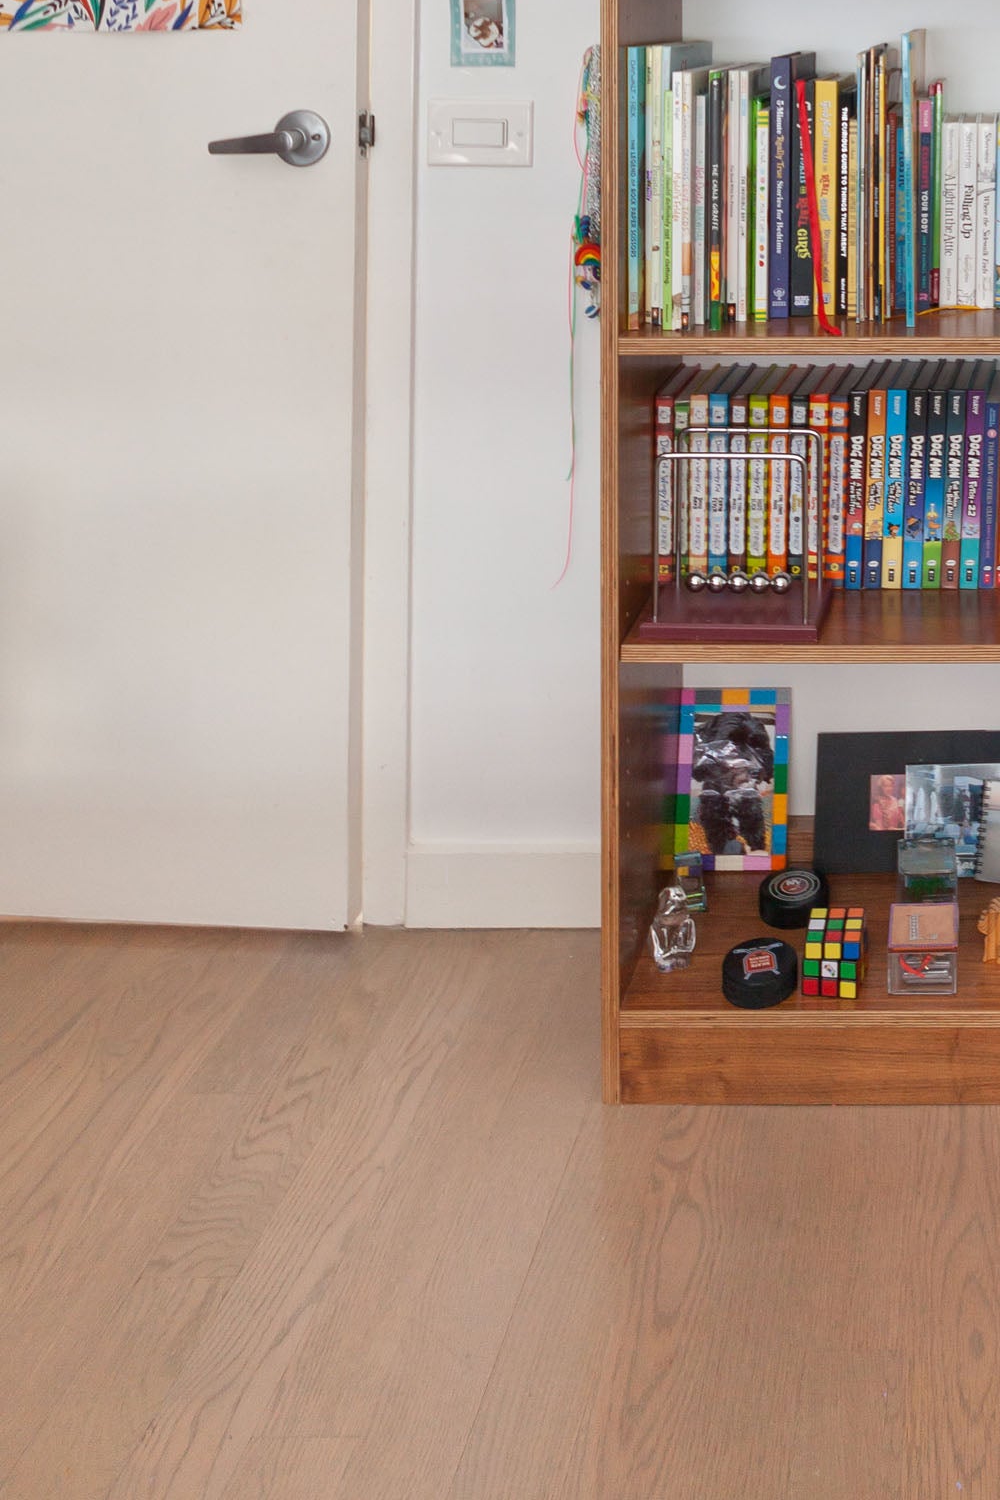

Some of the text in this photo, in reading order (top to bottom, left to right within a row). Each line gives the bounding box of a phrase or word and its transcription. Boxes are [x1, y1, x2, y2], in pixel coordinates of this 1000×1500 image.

[776, 100, 784, 134] 5-Minute
[776, 161, 784, 179] True
[820, 175, 830, 196] REBEL
[841, 176, 847, 185] TO
[776, 180, 784, 207] Stories
[943, 183, 956, 205] Light
[776, 209, 784, 220] for
[921, 190, 929, 233] YOUR BODY
[945, 217, 956, 233] the
[960, 185, 974, 238] Falling Up
[776, 222, 784, 253] Bedtime
[944, 233, 956, 256] Attic
[850, 435, 864, 479] DOG MAN
[870, 435, 884, 478] DOG MAN
[889, 435, 903, 478] DOG MAN
[910, 435, 924, 479] DOG MAN
[929, 435, 943, 478] DOG MAN
[948, 435, 962, 478] DOG MAN
[968, 435, 982, 478] DOG MAN
